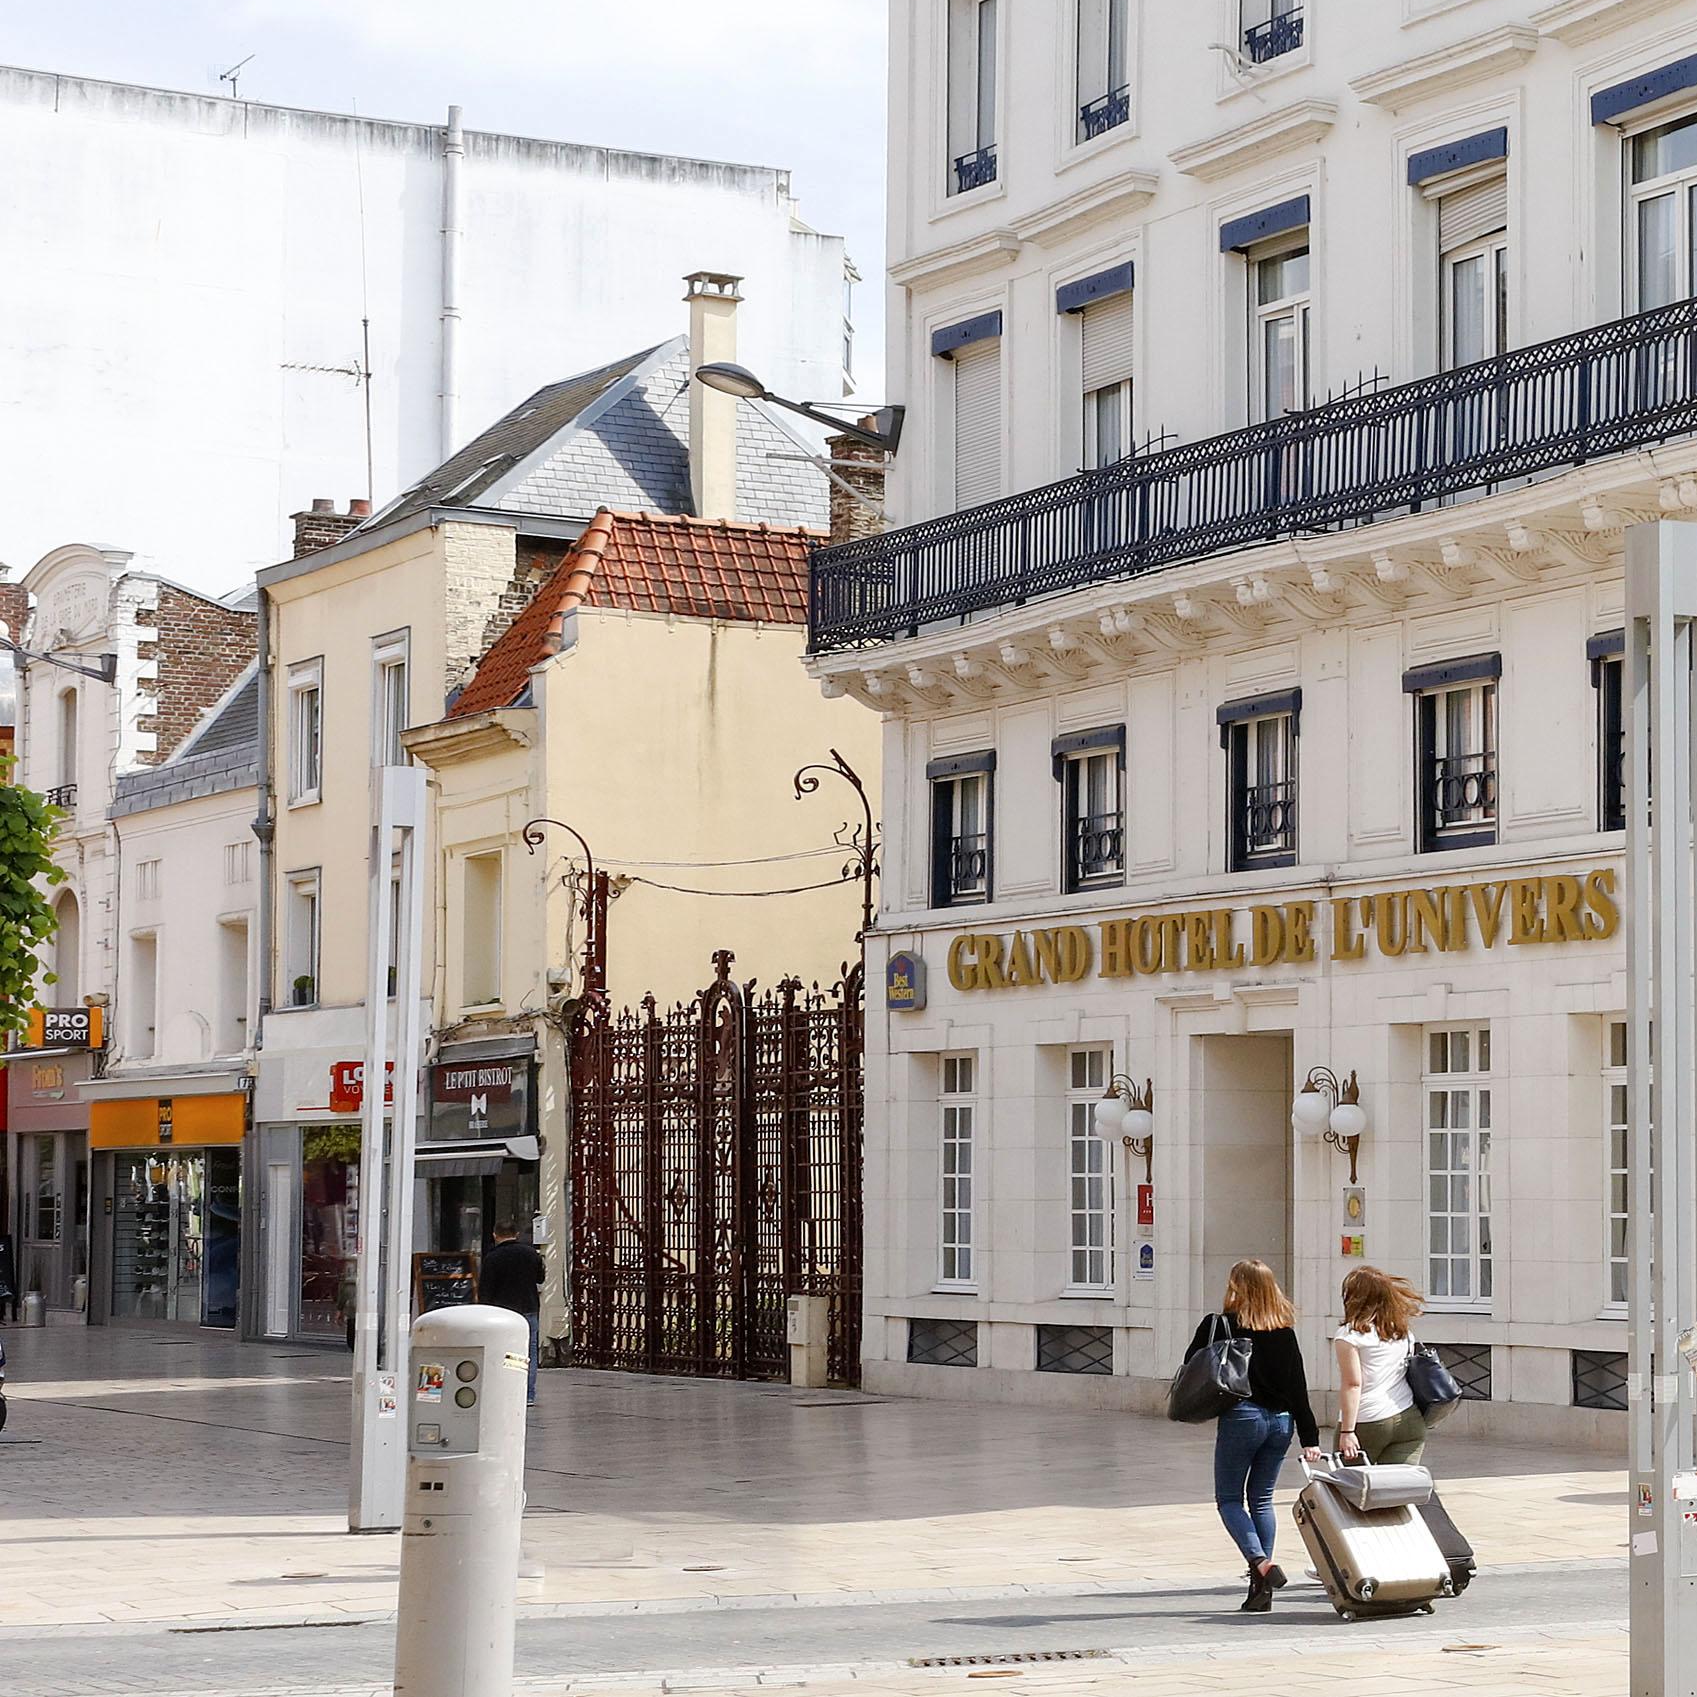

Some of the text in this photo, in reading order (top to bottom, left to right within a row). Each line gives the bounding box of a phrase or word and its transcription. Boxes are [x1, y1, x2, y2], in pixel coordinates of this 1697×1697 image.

[948, 868, 1620, 991] GRAND HOTEL DE L'UNIVERS
[45, 1014, 88, 1028] PRO
[45, 1029, 89, 1042] SPORT
[446, 1072, 457, 1089] LE
[478, 1067, 512, 1086] BISTROT
